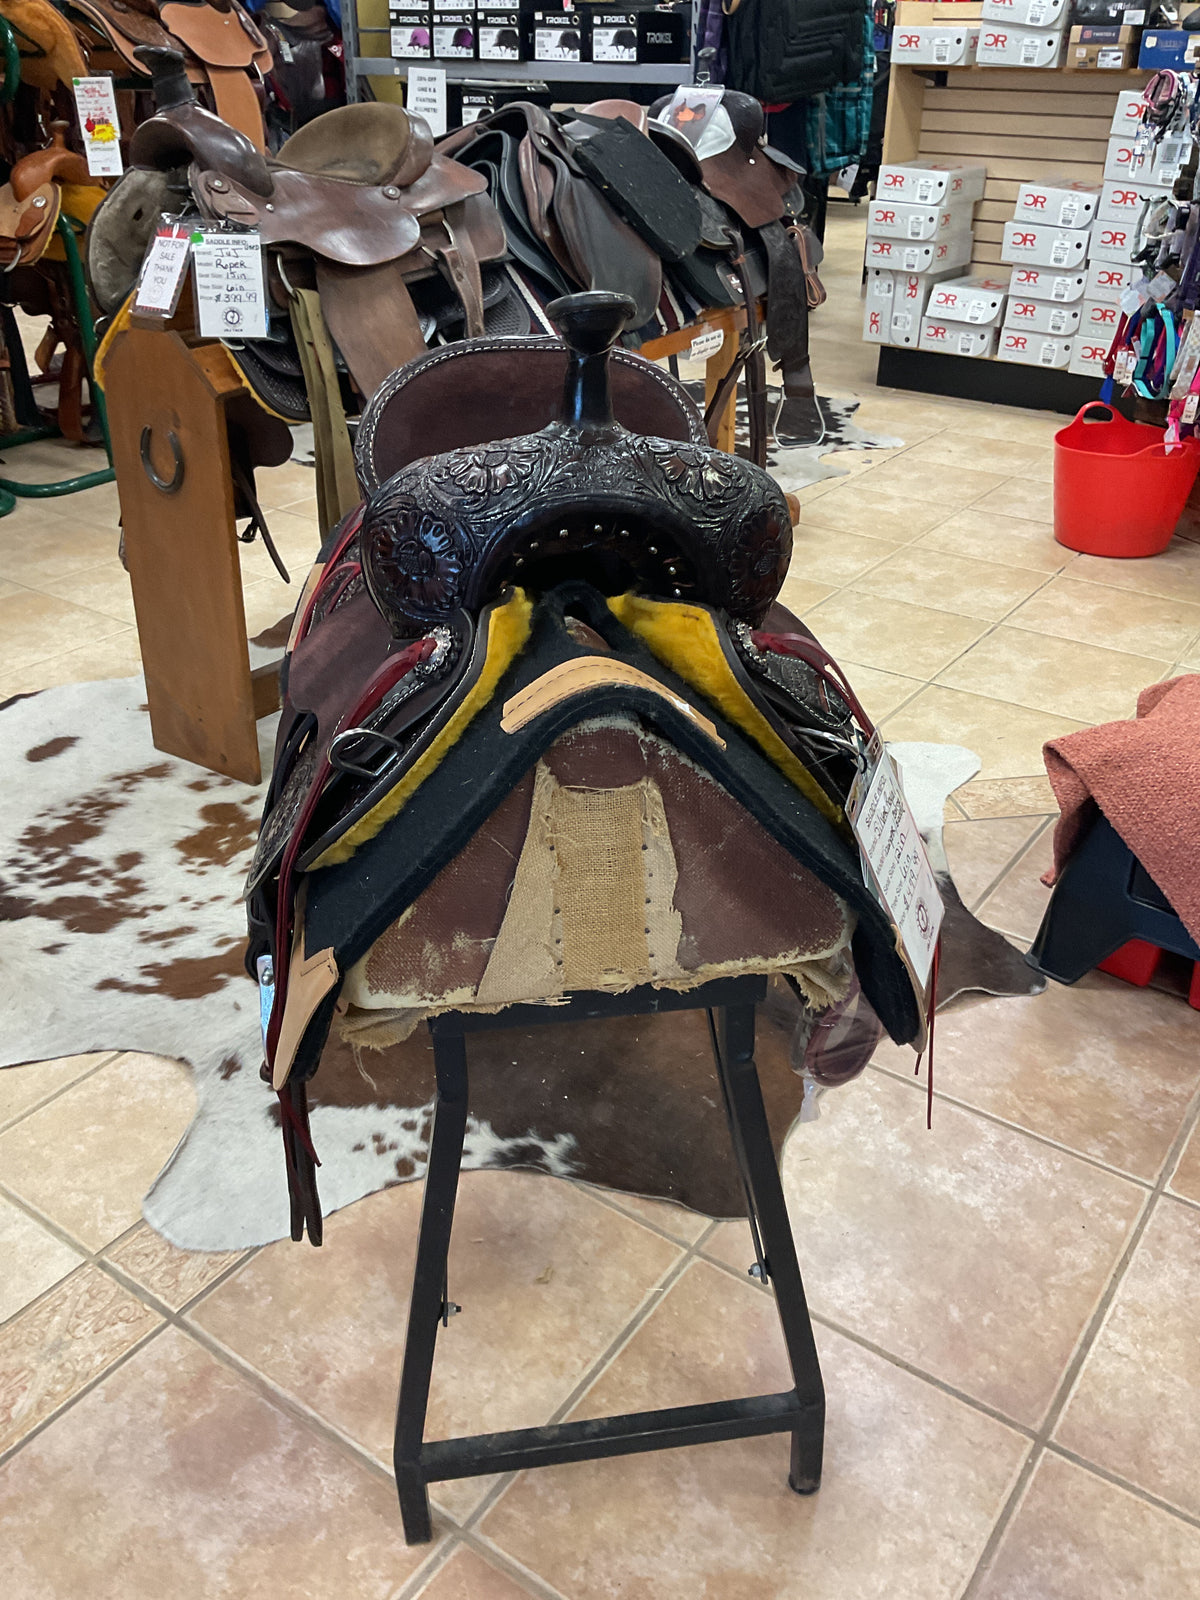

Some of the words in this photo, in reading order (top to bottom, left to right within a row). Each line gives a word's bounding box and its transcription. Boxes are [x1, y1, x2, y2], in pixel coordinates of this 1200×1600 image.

[545, 16, 570, 24] TROXEL
[603, 15, 627, 23] TROXEL
[646, 32, 673, 44] TROXEL
[158, 240, 171, 248] NOT
[172, 240, 185, 249] FOR
[160, 251, 176, 261] SALE
[154, 264, 174, 273] THANK
[153, 277, 168, 285] YOU
[865, 793, 879, 829] SADDLE
